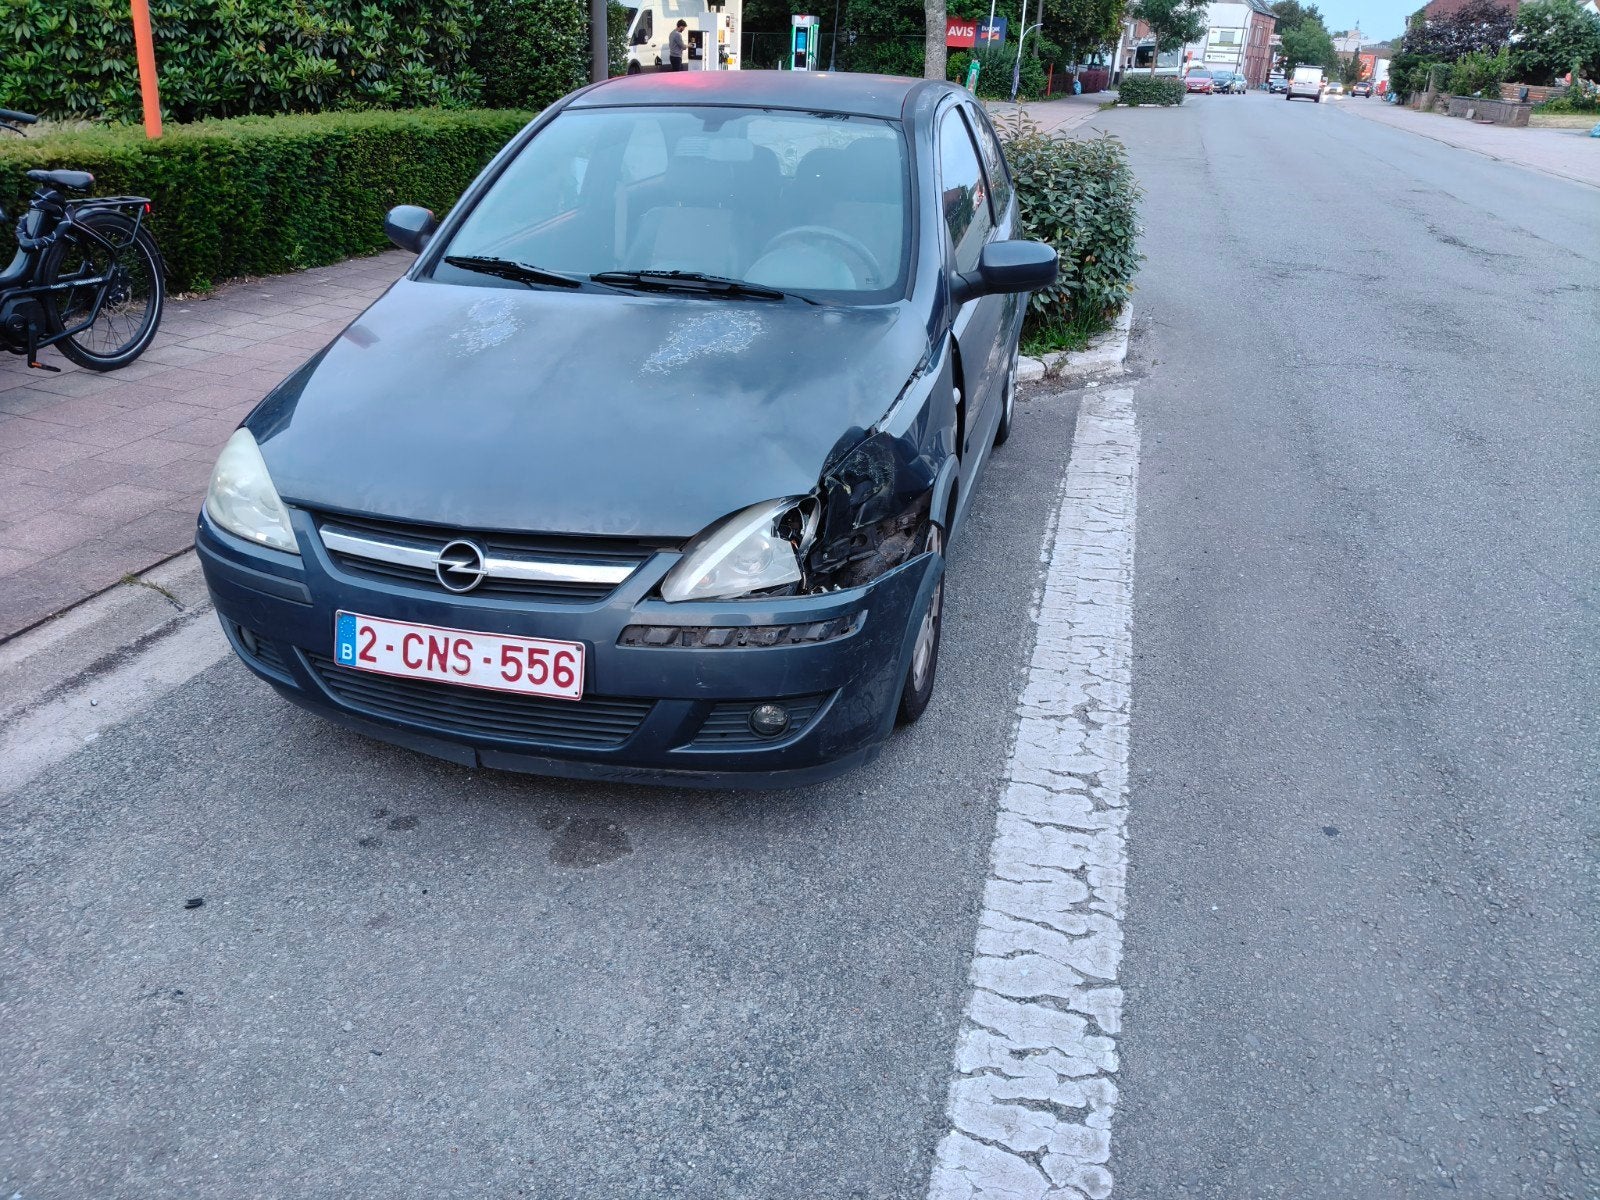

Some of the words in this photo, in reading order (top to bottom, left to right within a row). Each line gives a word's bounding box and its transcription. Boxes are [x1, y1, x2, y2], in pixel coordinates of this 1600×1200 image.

[947, 25, 974, 37] AVIS
[341, 642, 353, 660] B
[358, 625, 576, 688] 2-CNS-556
